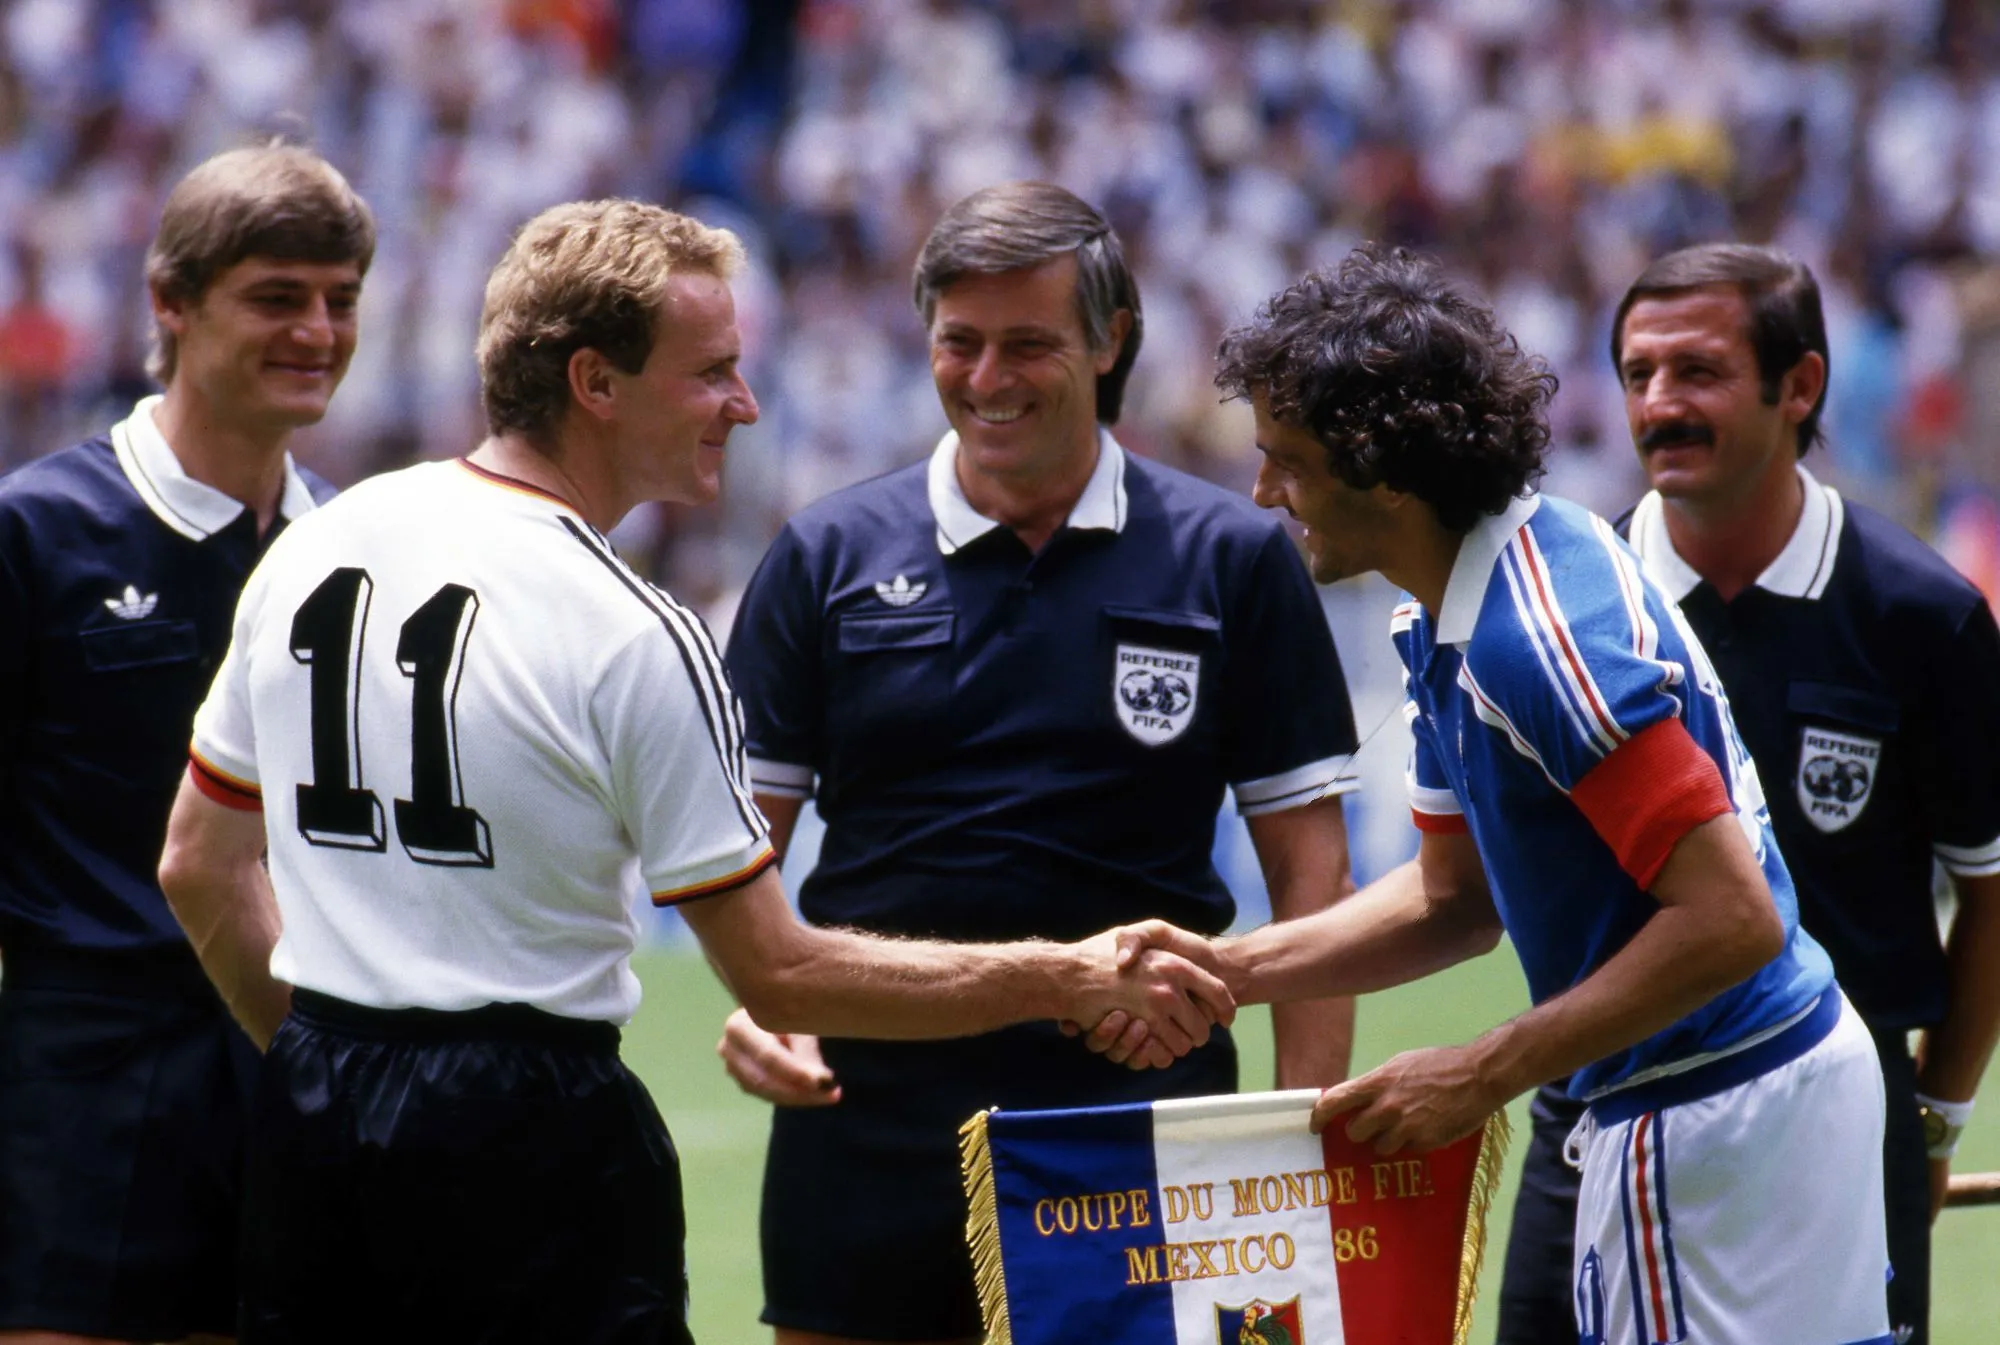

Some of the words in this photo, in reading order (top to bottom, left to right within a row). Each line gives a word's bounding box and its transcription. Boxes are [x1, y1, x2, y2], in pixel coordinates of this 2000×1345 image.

[1121, 652, 1196, 672] REFEREE
[289, 567, 494, 868] 11
[1132, 714, 1174, 731] FIFA
[1034, 1189, 1151, 1236] COUPE
[1163, 1182, 1214, 1224] DU
[1229, 1166, 1358, 1217] MONDE
[1124, 1231, 1296, 1285] MEXICO
[1334, 1225, 1379, 1262] 86
